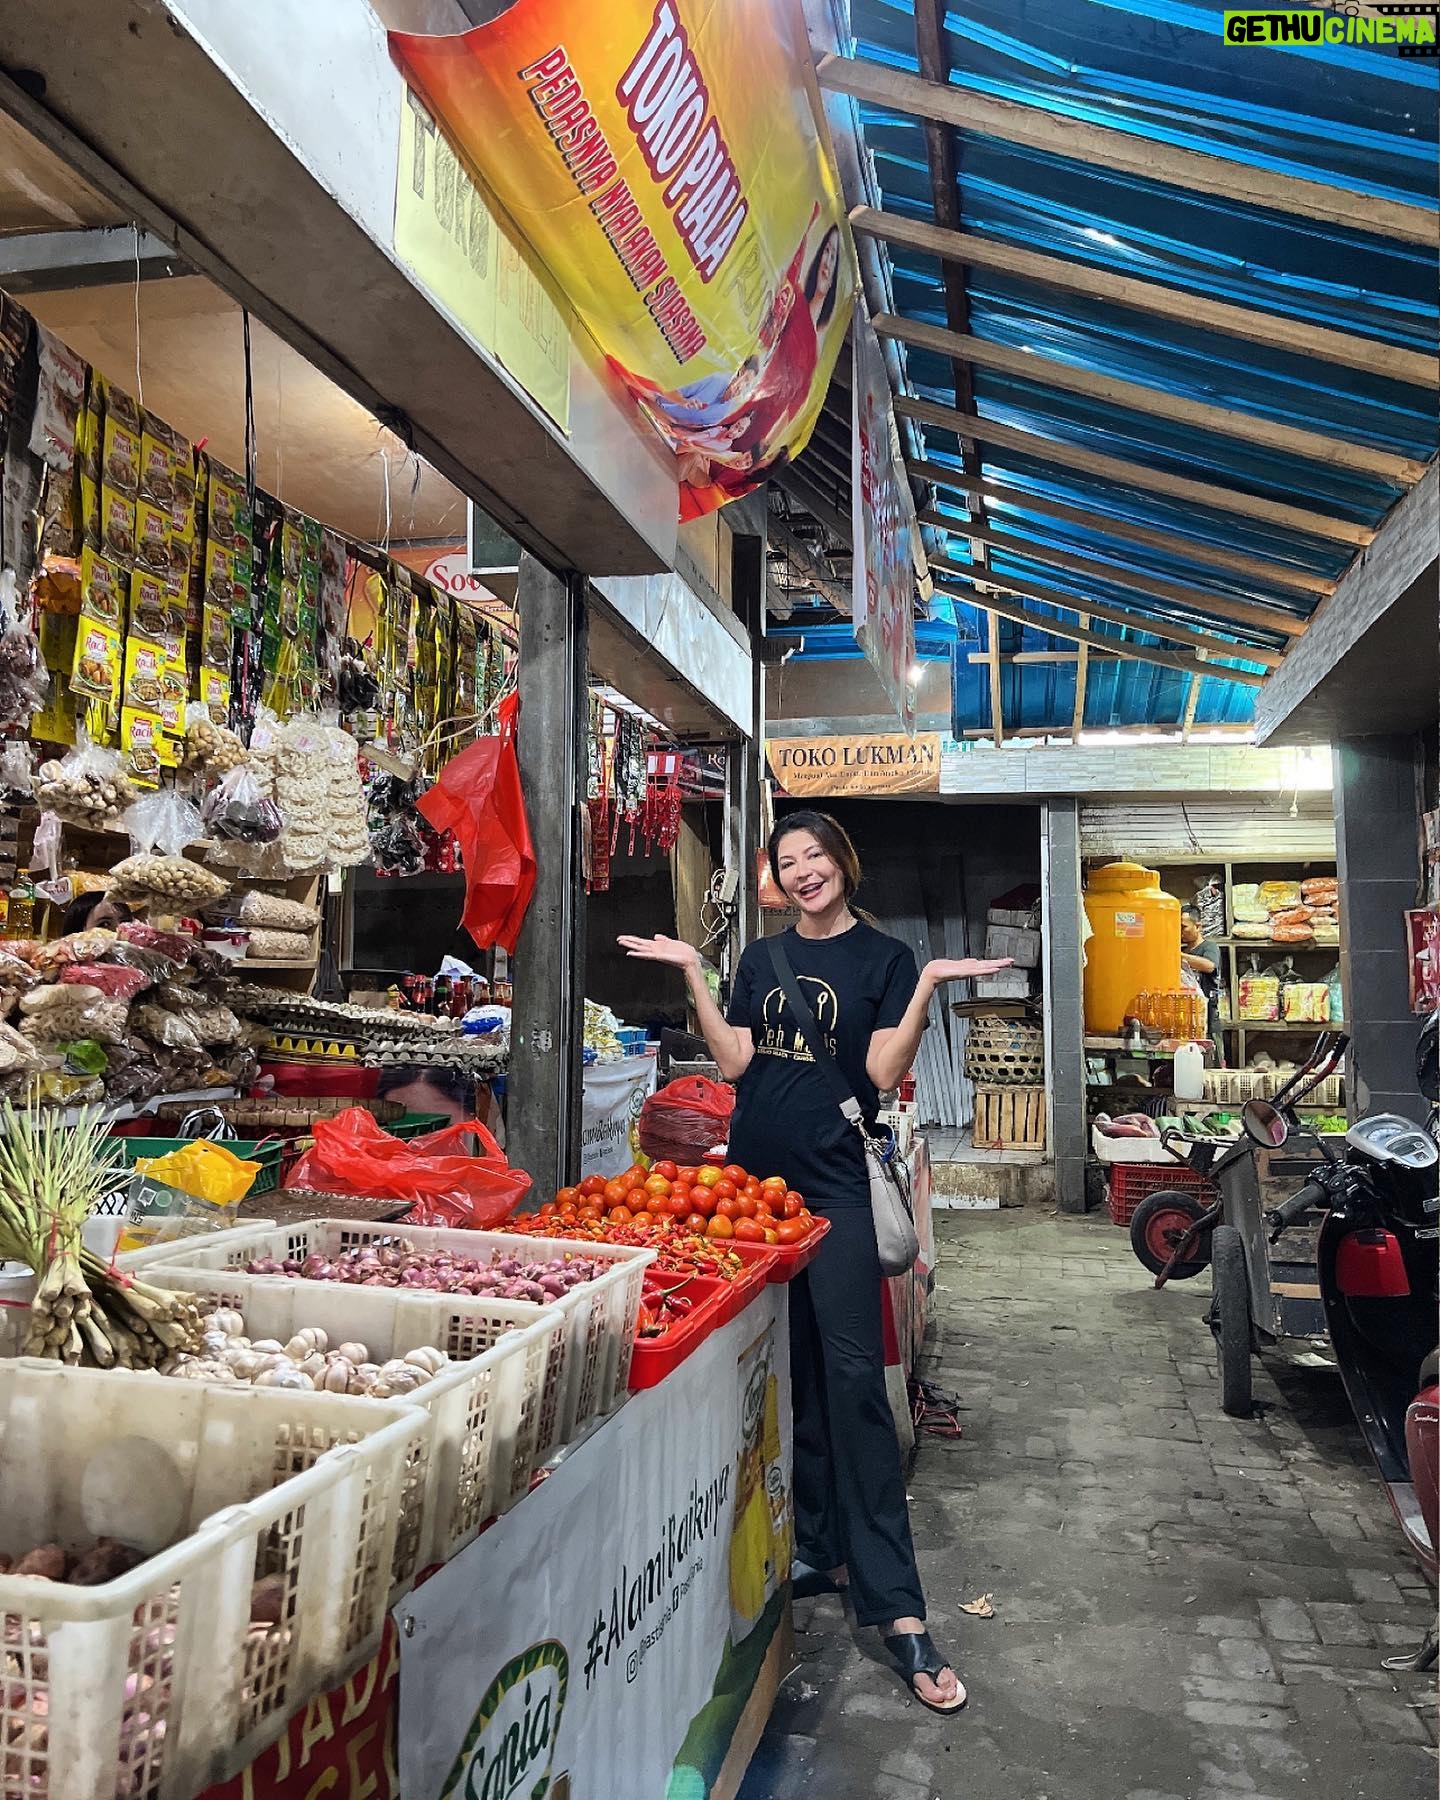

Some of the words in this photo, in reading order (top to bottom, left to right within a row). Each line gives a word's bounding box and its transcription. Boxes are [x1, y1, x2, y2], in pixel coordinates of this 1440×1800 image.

[519, 44, 620, 196] PEDASNYA
[588, 176, 668, 293] NYALAKAN
[643, 275, 708, 366] SUASANA
[620, 0, 705, 175] TOKO
[666, 123, 747, 278] PIALA
[779, 747, 837, 767] TOKO
[843, 744, 934, 766] LUKMAN
[583, 1464, 730, 1690] #AlamiBaiknya
